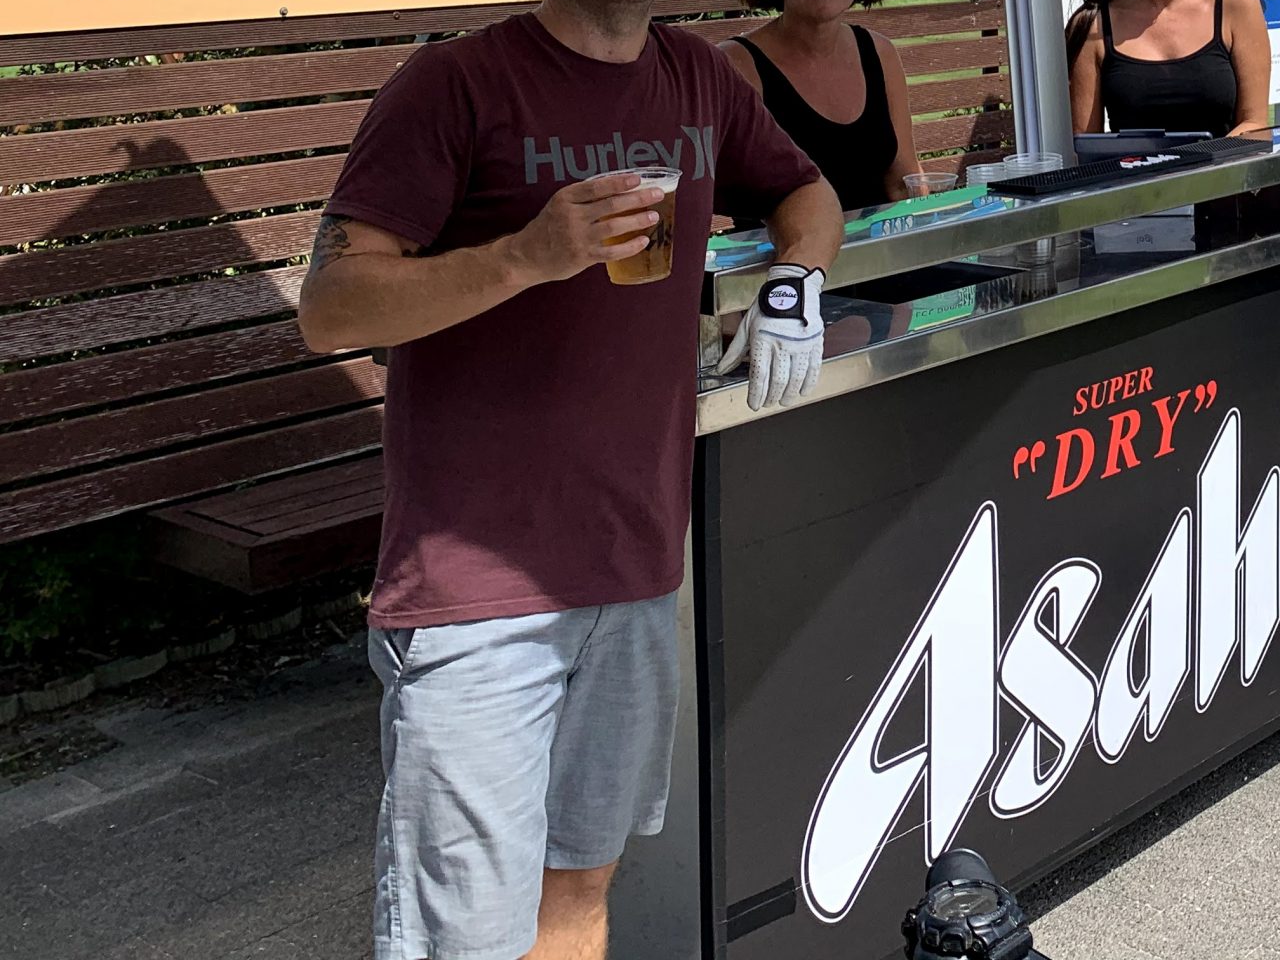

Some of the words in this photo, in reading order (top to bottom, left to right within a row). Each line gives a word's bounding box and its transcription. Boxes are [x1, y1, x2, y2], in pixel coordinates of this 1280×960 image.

[523, 131, 683, 184] Hurley
[1073, 366, 1153, 416] SUPER
[1013, 380, 1218, 500] "DRY"
